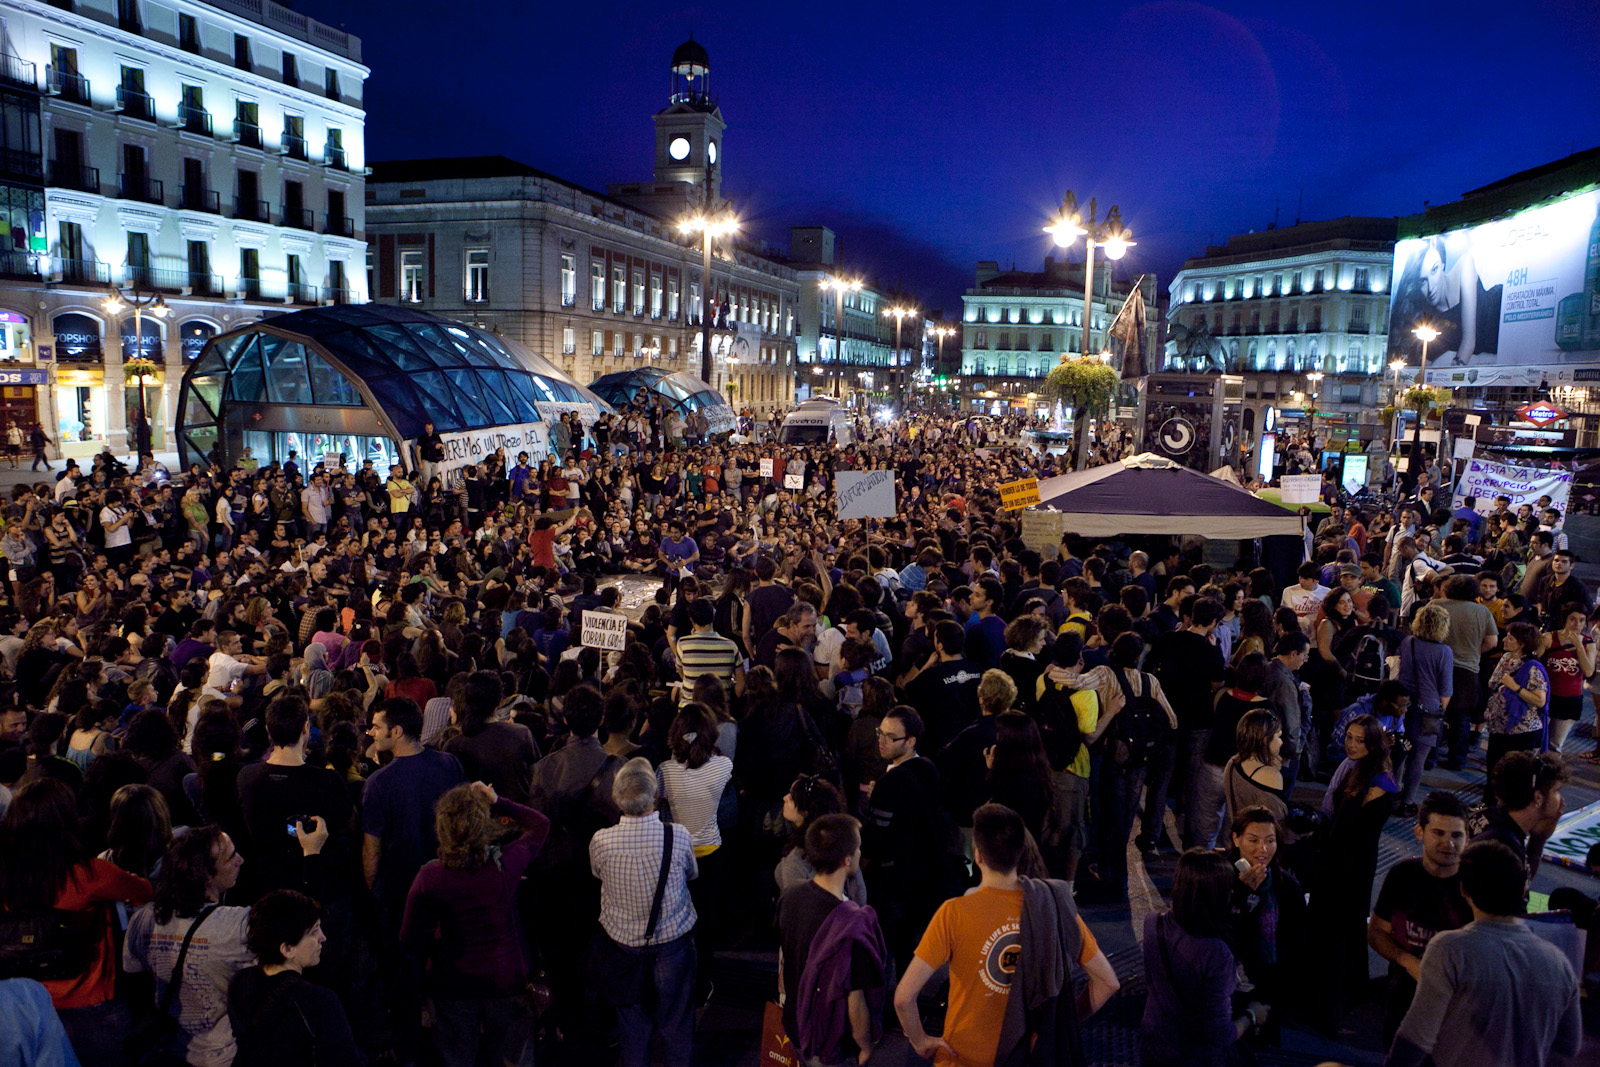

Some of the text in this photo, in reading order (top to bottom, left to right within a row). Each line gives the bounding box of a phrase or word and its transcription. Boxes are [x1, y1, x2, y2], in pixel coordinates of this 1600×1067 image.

[1507, 267, 1528, 287] 48H
[55, 333, 98, 344] TOPSHOP
[121, 335, 161, 346] TOPHOP
[1530, 410, 1554, 418] Metro
[525, 430, 541, 446] DEL
[1512, 468, 1528, 480] YA
[618, 620, 626, 633] ES
[980, 940, 991, 956] LIVE
[989, 928, 1003, 942] LIFE
[1001, 923, 1011, 932] DC
